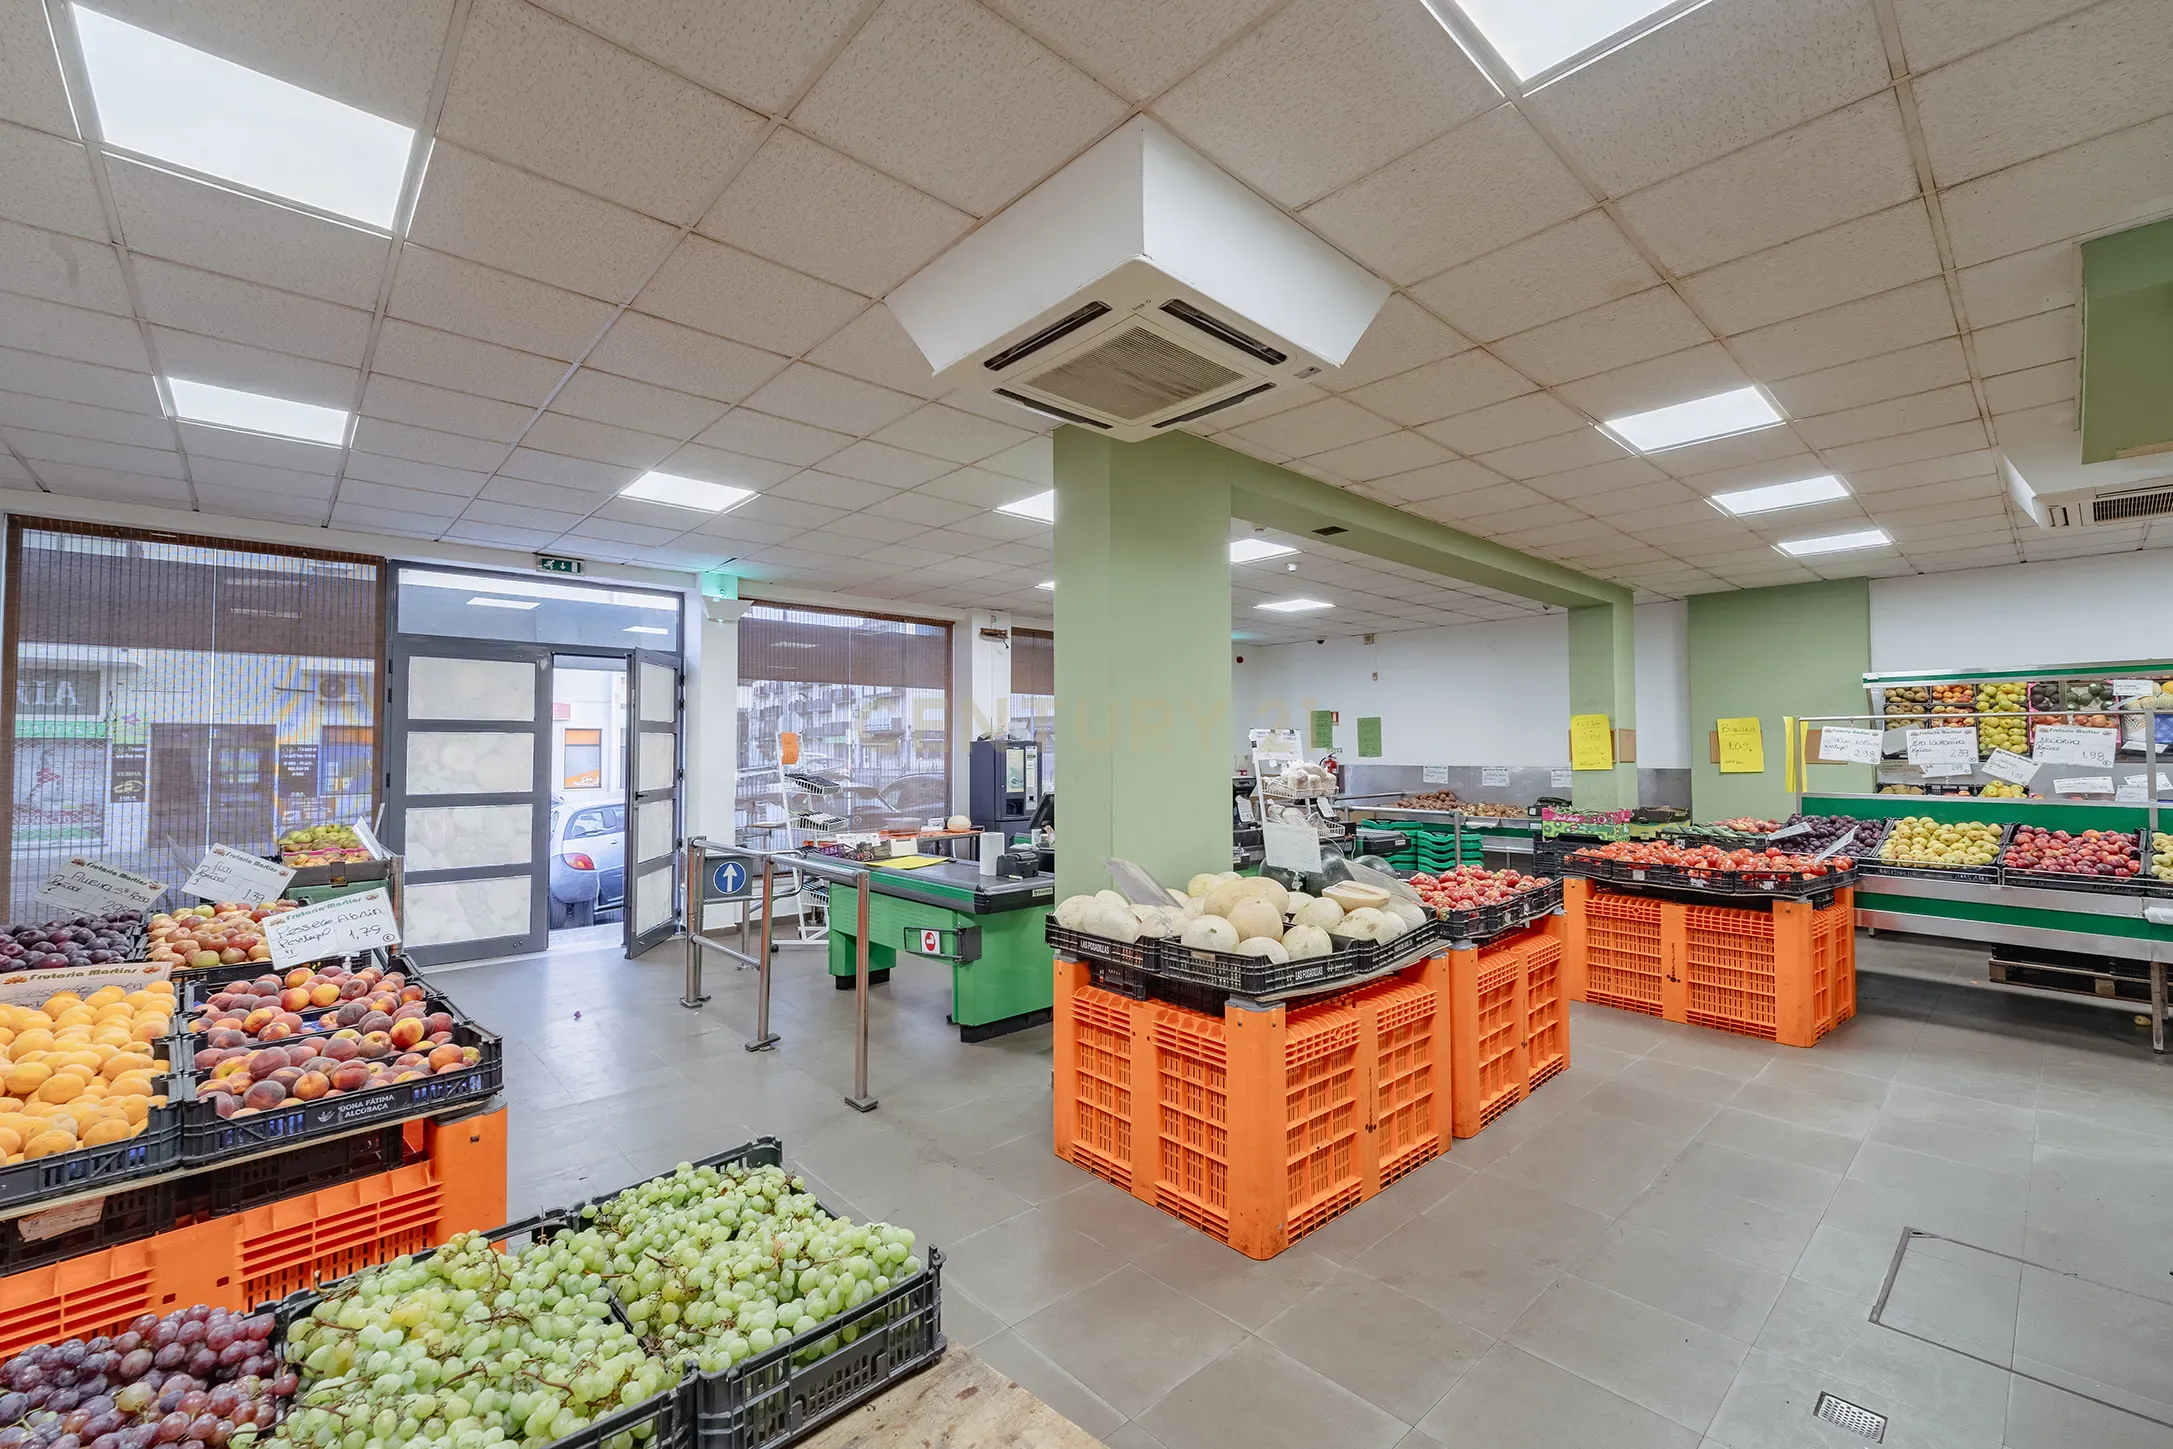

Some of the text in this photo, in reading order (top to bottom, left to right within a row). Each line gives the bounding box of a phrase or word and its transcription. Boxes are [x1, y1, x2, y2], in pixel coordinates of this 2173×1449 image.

[225, 851, 277, 873] Frutaria Martins
[86, 862, 148, 886] Frutaria Martins
[286, 897, 362, 921] Frutaria Martins
[29, 967, 137, 981] Frutaria Martins
[340, 1094, 395, 1112] DONA FÁTIMA
[344, 1103, 389, 1118] ALCOBAÇA
